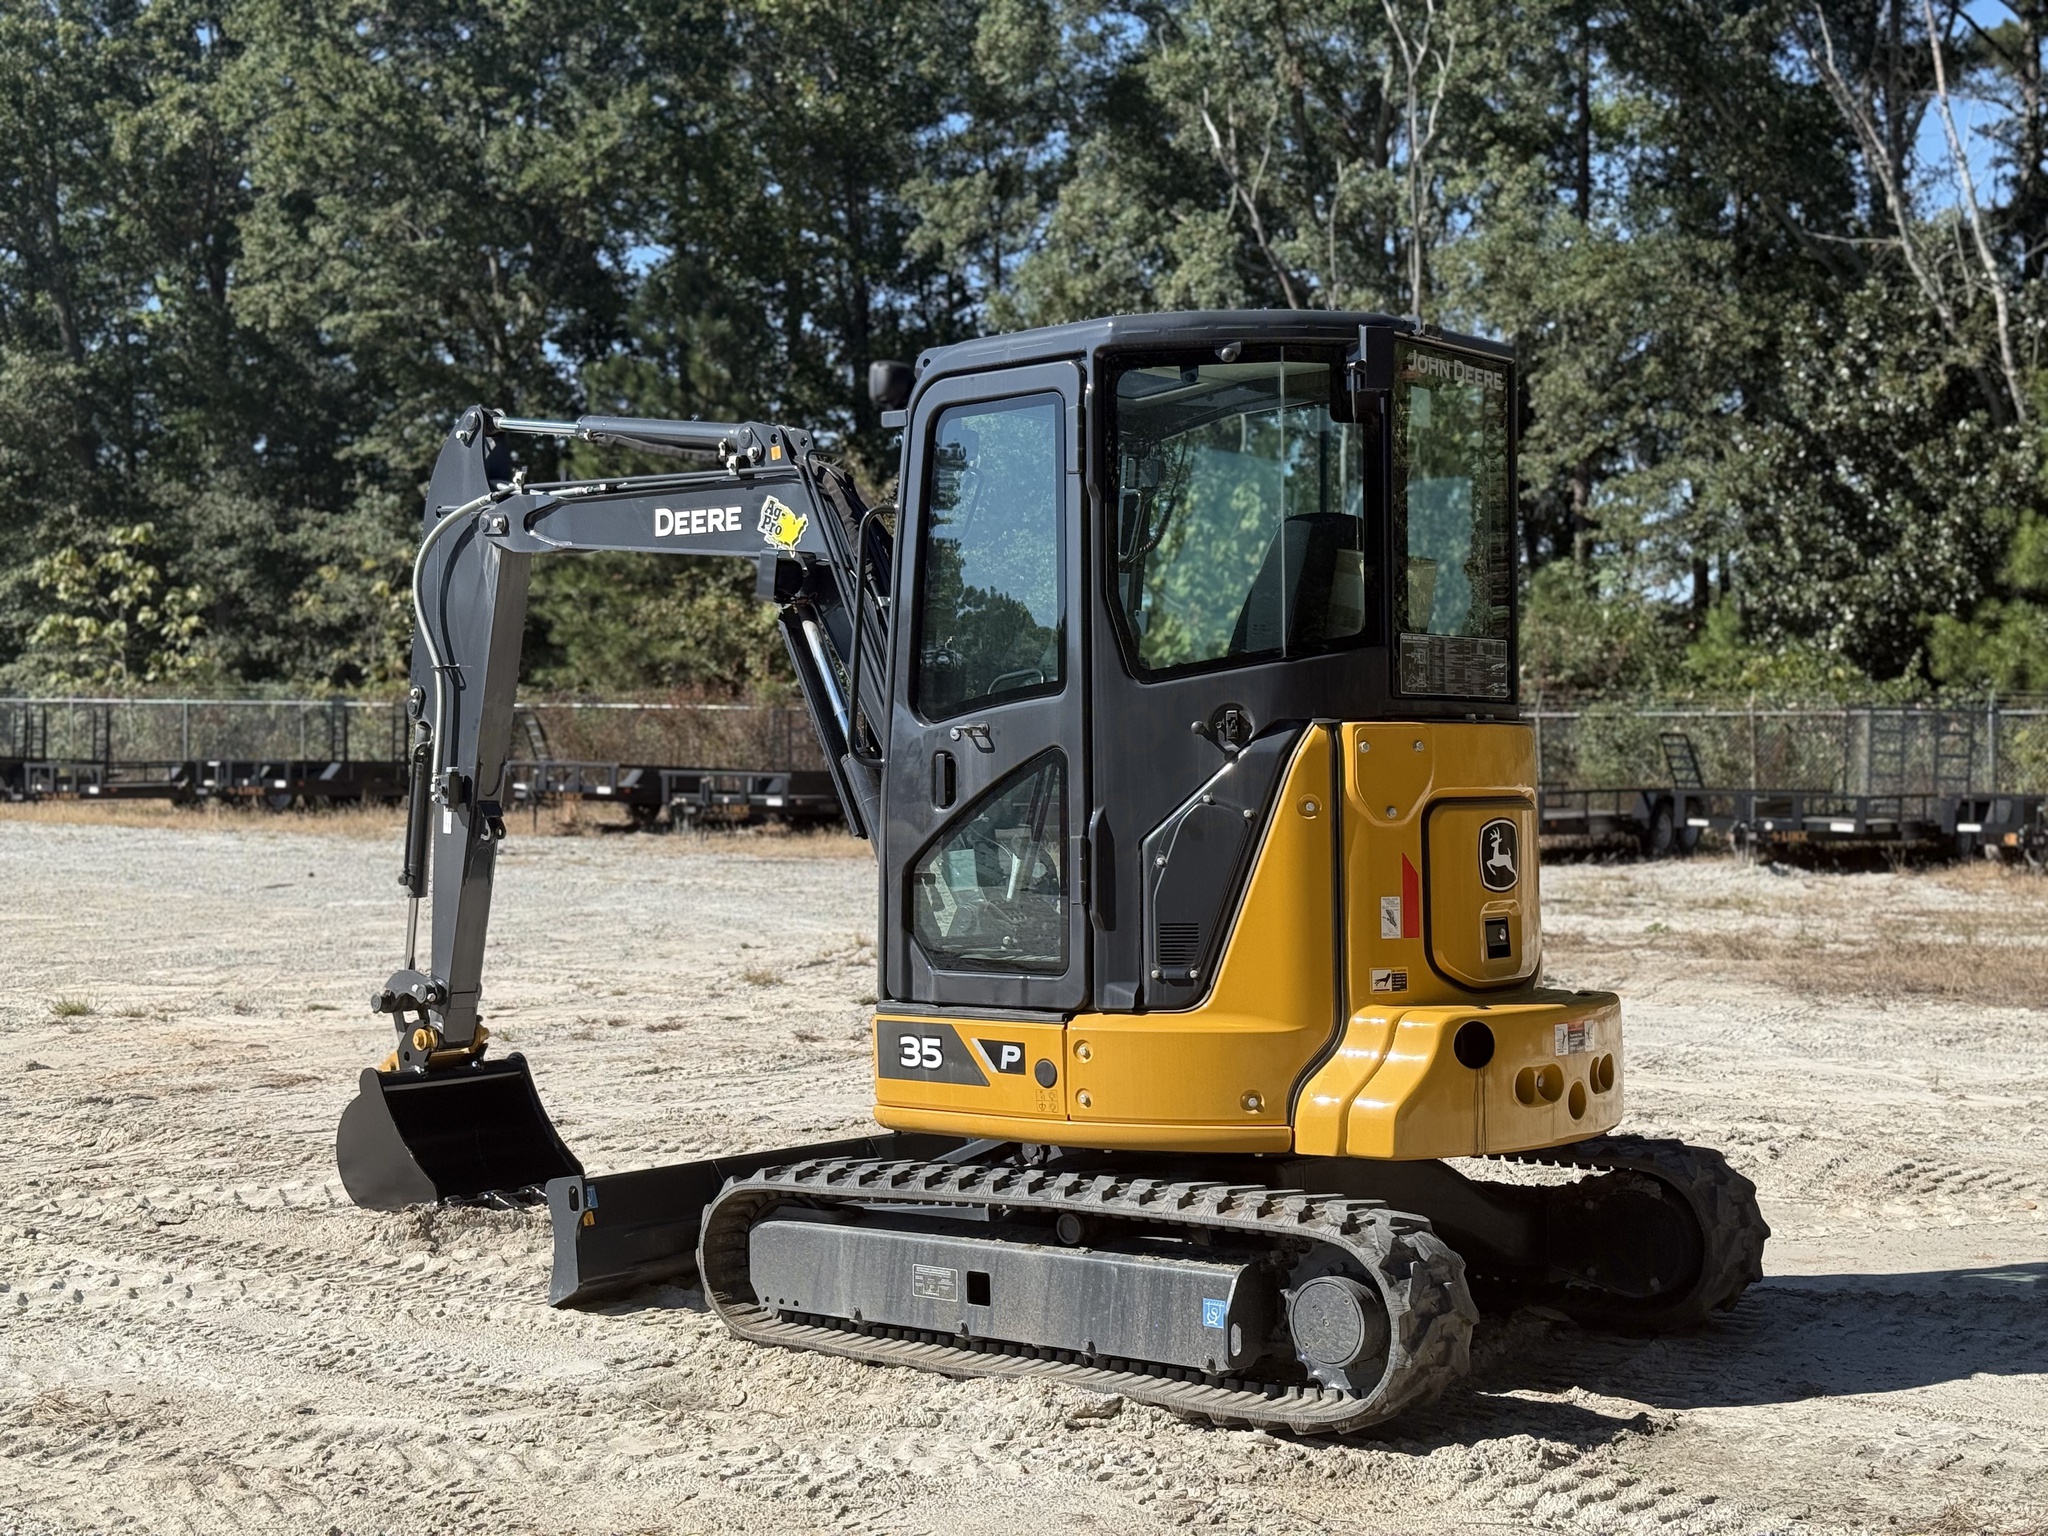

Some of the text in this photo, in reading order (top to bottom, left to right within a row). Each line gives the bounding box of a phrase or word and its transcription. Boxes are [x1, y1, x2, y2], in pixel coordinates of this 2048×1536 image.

[1406, 349, 1505, 391] JOHN DEERE
[654, 506, 742, 538] DEERE
[760, 514, 783, 536] Pro
[764, 500, 787, 522] Ag-
[899, 1035, 1021, 1070] 35 P
